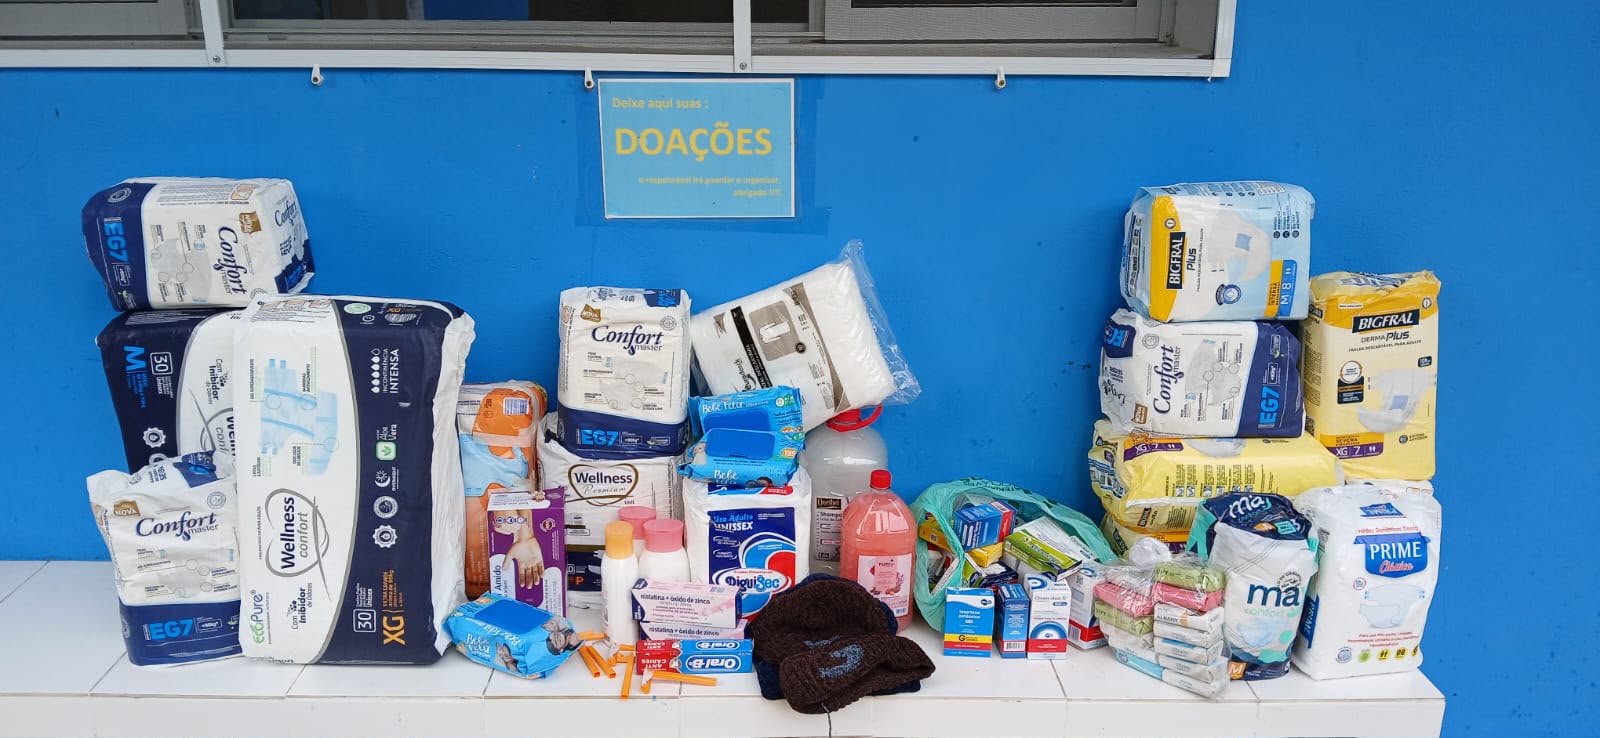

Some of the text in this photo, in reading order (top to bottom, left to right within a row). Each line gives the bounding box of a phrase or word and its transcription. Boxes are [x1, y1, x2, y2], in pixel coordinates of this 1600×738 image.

[612, 97, 645, 109] Deixe
[648, 97, 673, 111] aqui
[676, 99, 702, 109] suas
[615, 121, 773, 163] DOAÇÕES
[103, 221, 130, 263] EG7
[213, 226, 248, 296] Confort
[1169, 236, 1185, 285] BIGFRAL
[1186, 247, 1197, 271] Plus
[219, 269, 233, 295] master
[1280, 282, 1293, 306] M 8
[1358, 312, 1414, 330] BIGFRAL
[591, 325, 664, 350] Confort
[1360, 330, 1410, 344] DERMA Plus
[123, 345, 148, 371] M
[634, 344, 663, 352] master
[153, 355, 168, 373] 30
[215, 358, 224, 374] Com
[1172, 346, 1182, 373] master
[390, 348, 400, 395] INTENSA
[1151, 343, 1179, 415] Confort
[208, 365, 220, 401] Inibidor
[1258, 384, 1282, 426] EG7
[381, 426, 389, 441] Aloe
[388, 424, 398, 441] Vera
[581, 429, 620, 447] EG7
[1135, 443, 1148, 454] XG
[1335, 446, 1361, 457] XG 7
[574, 472, 634, 484] Wellness
[584, 484, 627, 495] Premium
[136, 511, 218, 541] Confort
[713, 521, 754, 533] UNISSEX
[728, 513, 754, 523] Adulto
[188, 524, 219, 535] master
[280, 495, 296, 571] Wellness
[297, 510, 309, 560] confort
[1369, 541, 1423, 561] PRIME
[494, 564, 503, 592] Amido
[297, 586, 307, 625] Inibidor
[640, 593, 666, 602] nistatina
[669, 595, 687, 604] óxido
[686, 596, 694, 604] de
[694, 597, 711, 606] zinco
[149, 618, 194, 641] EG7
[291, 616, 300, 631] Com
[356, 610, 373, 630] 30
[381, 615, 408, 647] XG
[648, 626, 675, 634] nistatina
[678, 627, 695, 636] óxido
[695, 628, 703, 636] de
[703, 629, 720, 638] zinco
[698, 641, 736, 649] Oral-B
[690, 657, 737, 669] Oral-B
[1228, 661, 1246, 676] M
